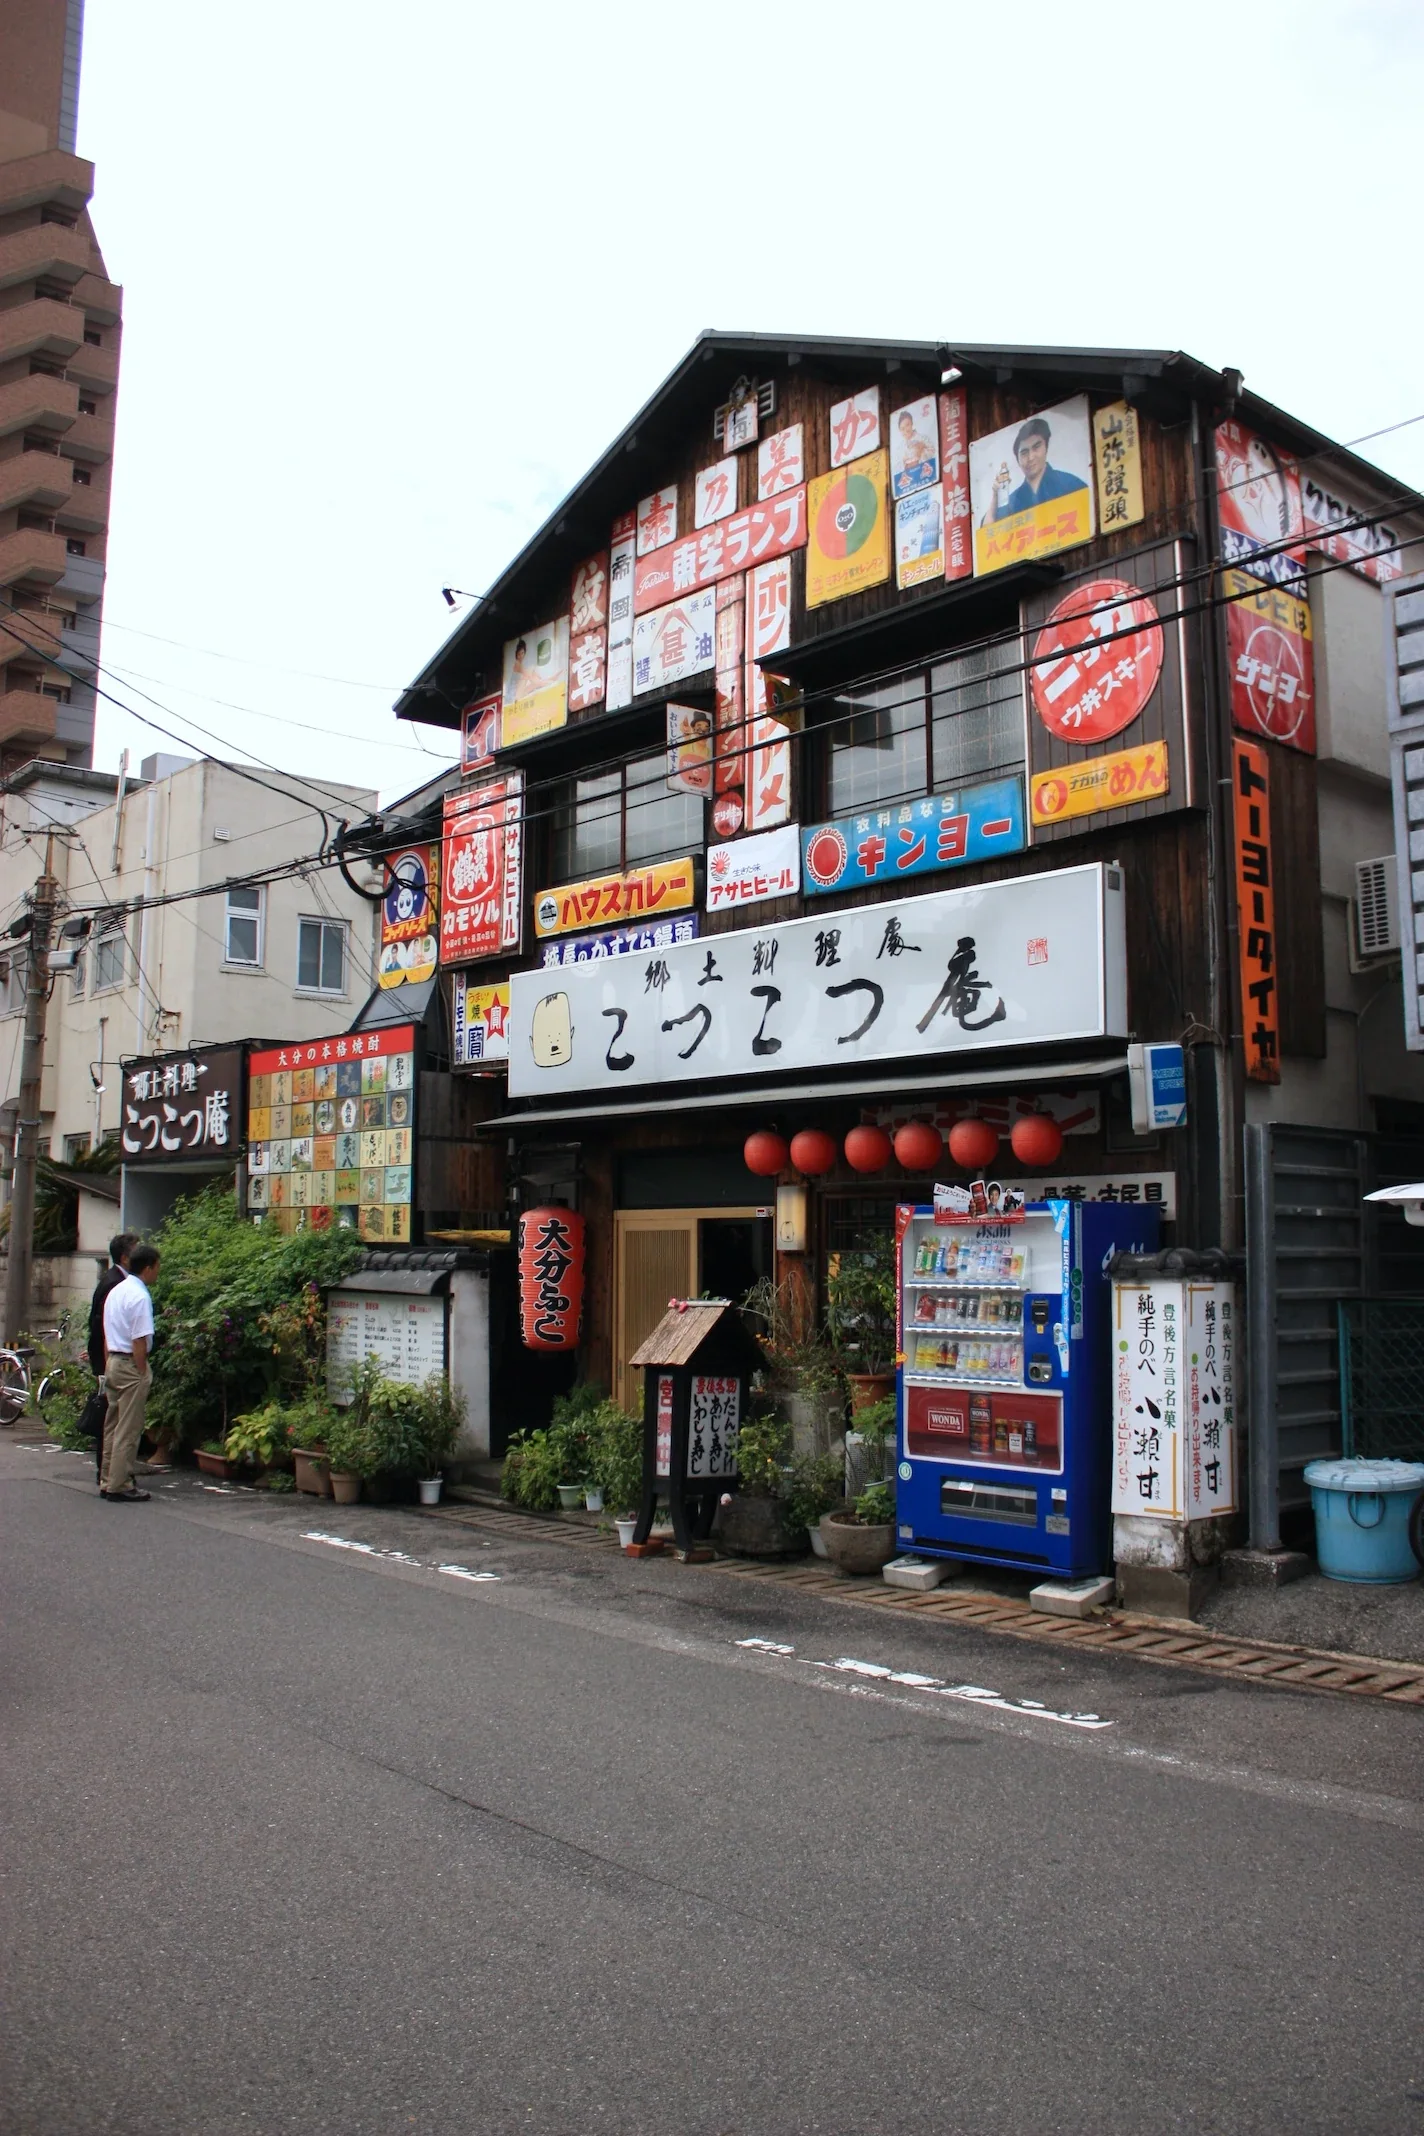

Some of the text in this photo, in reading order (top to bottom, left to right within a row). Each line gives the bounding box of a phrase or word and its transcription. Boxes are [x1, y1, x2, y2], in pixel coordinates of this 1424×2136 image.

[760, 431, 800, 486] 美
[832, 402, 877, 462] か
[639, 494, 674, 549] 素
[704, 473, 728, 517] 乃
[673, 490, 805, 592] 東芝ランプ
[986, 510, 1079, 561] ハイアース
[637, 571, 670, 595] Toshiba
[695, 632, 712, 661] 油
[1035, 590, 1135, 704] ニッカ
[1235, 653, 1311, 704] サンヨー
[1109, 754, 1165, 796] めん
[857, 797, 955, 833] 衣料品なら
[857, 815, 1012, 877] キンヨー
[562, 872, 688, 926] ハウスカレー
[710, 868, 794, 905] アサヒビール
[1238, 754, 1277, 1060] トーヨータイヤ
[443, 899, 500, 935] カモツル
[601, 937, 1007, 1071] こつこつ庵
[277, 1035, 381, 1067] 大分の本格焼酎
[133, 1062, 197, 1101] 郷土料理
[123, 1090, 230, 1153] こつこつ庵
[1137, 1294, 1156, 1376] 純手のべ
[1205, 1300, 1217, 1377] 純手のべ
[1162, 1304, 1176, 1429] 豊後方言名菓
[1221, 1302, 1233, 1425] 豊後方言名菓
[656, 1380, 673, 1469] 営業中
[931, 1414, 960, 1426] WONDA
